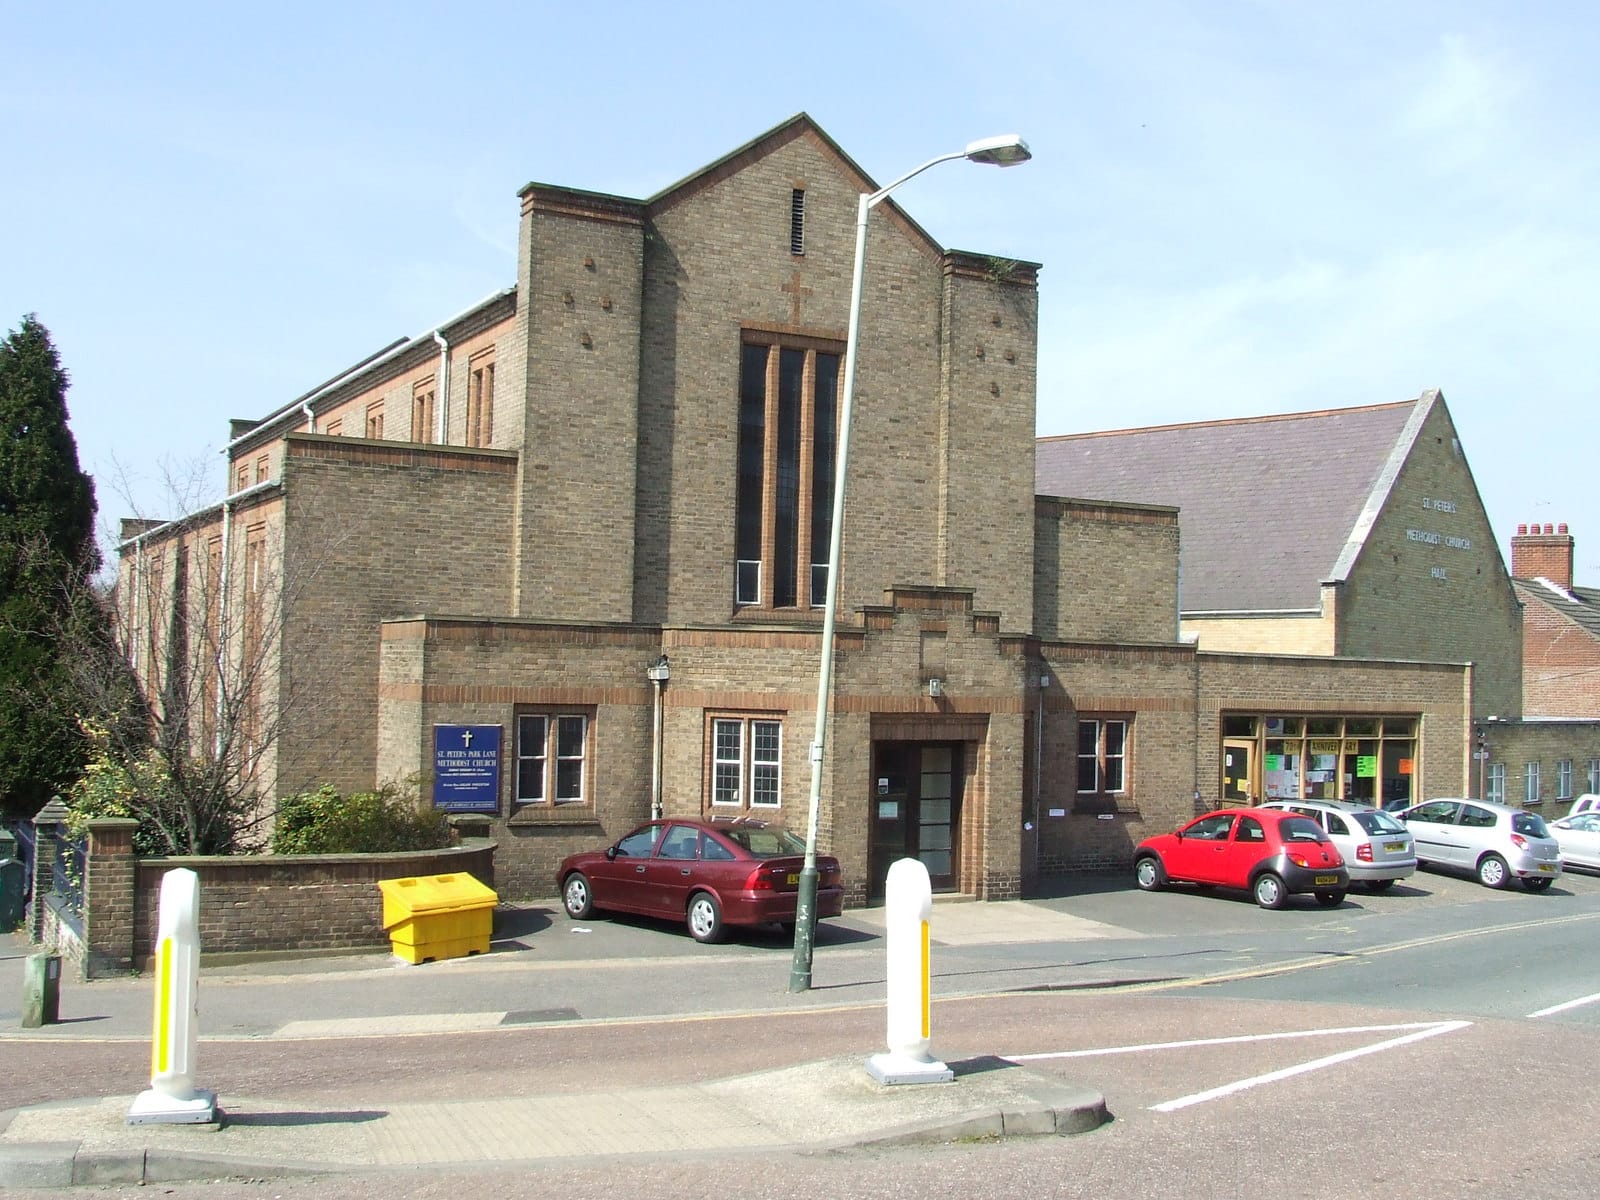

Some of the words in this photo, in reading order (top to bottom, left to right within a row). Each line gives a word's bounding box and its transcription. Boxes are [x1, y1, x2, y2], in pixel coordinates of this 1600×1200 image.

[1407, 529, 1440, 545] METHODIST
[1445, 536, 1471, 550] CHURCH
[1431, 567, 1448, 580] HALL
